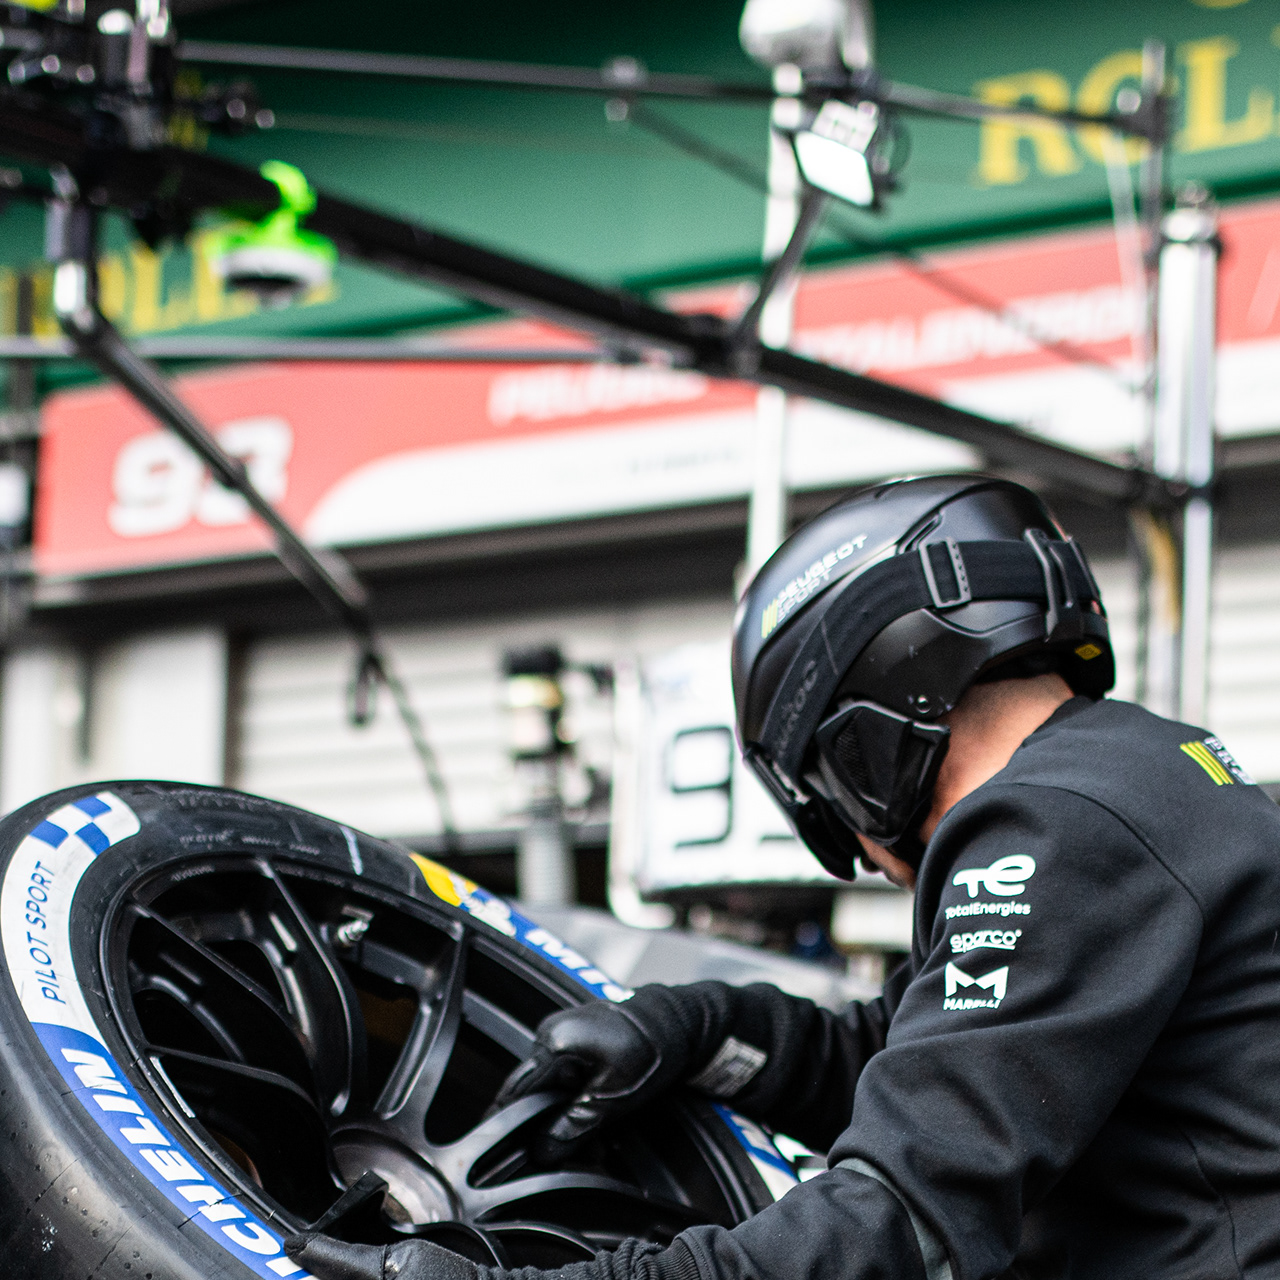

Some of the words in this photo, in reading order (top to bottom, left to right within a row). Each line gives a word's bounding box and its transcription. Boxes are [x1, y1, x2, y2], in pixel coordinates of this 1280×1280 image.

[777, 533, 868, 602] PEUGEOT
[26, 861, 55, 930] SPORT
[945, 901, 1031, 920] TotalEnergies
[27, 931, 66, 1005] PILOT
[950, 929, 1017, 953] sparco
